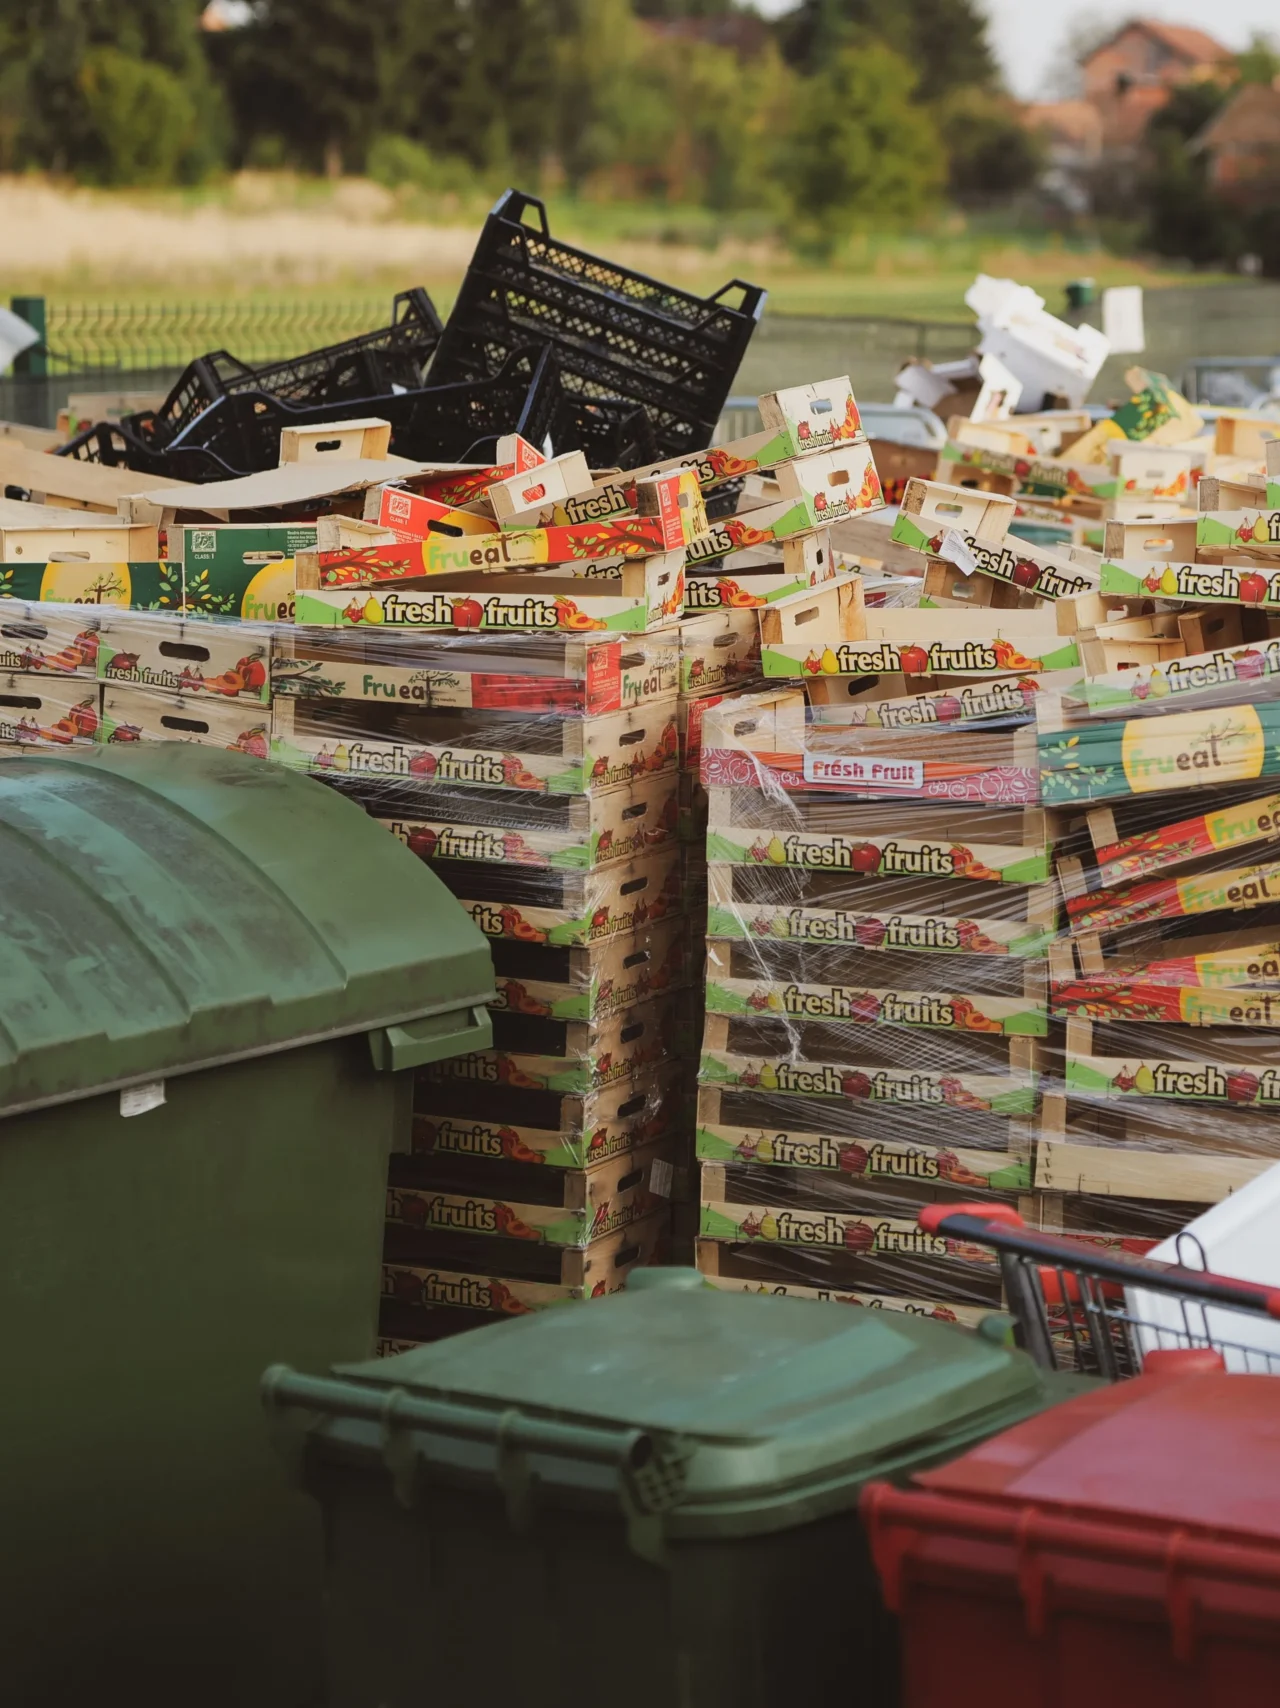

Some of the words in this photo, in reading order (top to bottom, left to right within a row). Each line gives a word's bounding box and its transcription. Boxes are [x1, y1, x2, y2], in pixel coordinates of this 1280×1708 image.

[799, 435, 816, 450] fresh
[816, 430, 832, 446] fruits
[565, 484, 626, 526] fresh
[814, 507, 831, 522] fresh
[831, 500, 849, 518] fruits
[1039, 565, 1092, 597] fruit
[1177, 566, 1239, 598] fresh
[383, 594, 454, 625] fresh
[486, 599, 559, 628] fruits
[836, 643, 900, 674] fresh
[929, 643, 997, 674] fruits
[1168, 654, 1235, 692] fresh
[106, 665, 141, 683] fresh
[142, 666, 179, 689] fruits
[878, 699, 938, 729] fresh
[961, 686, 1026, 719] fruits
[347, 742, 411, 776] fresh
[437, 750, 505, 785] fruits
[813, 759, 865, 780] Frésh
[870, 763, 916, 782] Fruit
[437, 827, 505, 862] fruits
[785, 835, 852, 867] fresh
[882, 843, 955, 876] fruits
[788, 910, 855, 942] fresh
[885, 918, 959, 949] fruits
[784, 985, 851, 1018] fresh
[882, 994, 954, 1026] fruits
[775, 1063, 842, 1096] fresh
[873, 1074, 944, 1104] fruits
[1153, 1063, 1227, 1098] fresh
[437, 1124, 502, 1157] fruits
[772, 1134, 838, 1168] fresh
[869, 1145, 940, 1179] fruits
[428, 1197, 497, 1231] fruits
[776, 1212, 844, 1246] fresh
[876, 1222, 948, 1256] fruits
[423, 1272, 492, 1309] fruits
